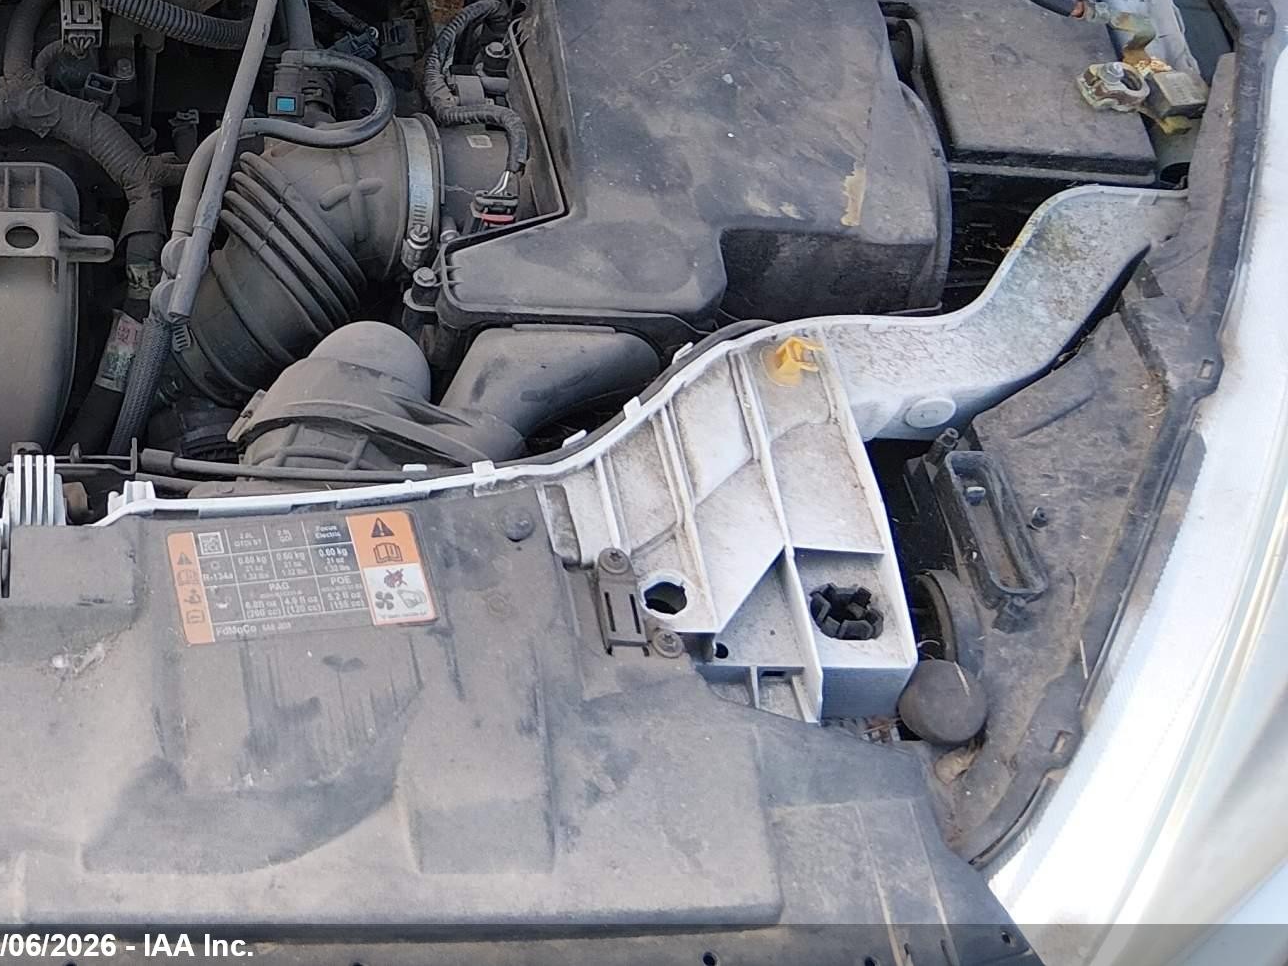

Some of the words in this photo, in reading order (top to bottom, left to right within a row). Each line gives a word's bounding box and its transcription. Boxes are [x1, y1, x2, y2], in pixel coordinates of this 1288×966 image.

[336, 547, 348, 556] kg
[330, 576, 352, 585] POE
[268, 582, 290, 591] PAG
